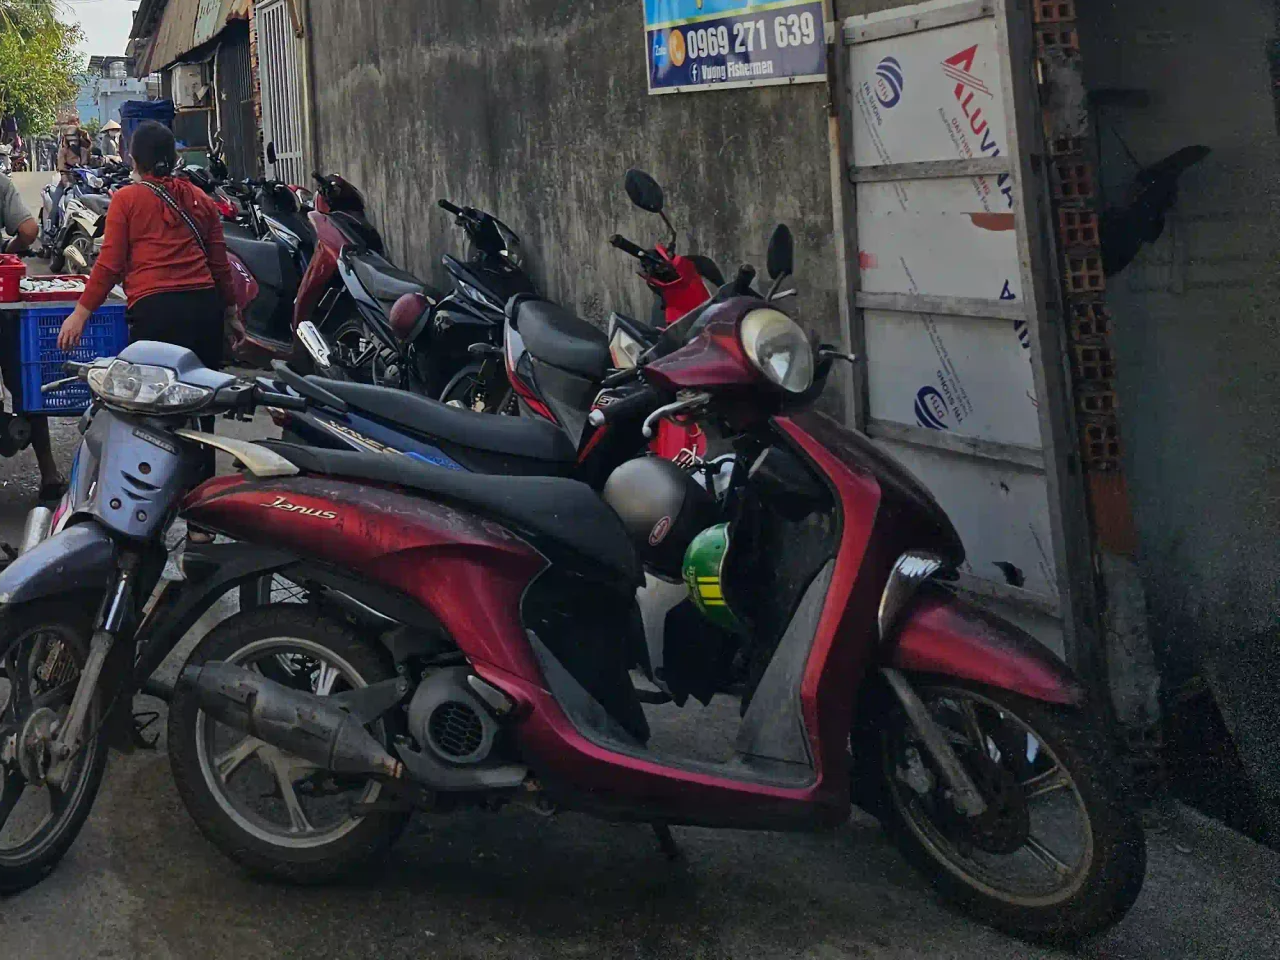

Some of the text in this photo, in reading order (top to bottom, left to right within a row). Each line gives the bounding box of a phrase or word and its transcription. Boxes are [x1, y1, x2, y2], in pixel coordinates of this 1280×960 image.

[687, 25, 729, 59] 0969
[733, 18, 766, 53] 271
[774, 11, 815, 46] 639
[726, 59, 774, 78] Fishermen
[260, 495, 338, 519] Janus
